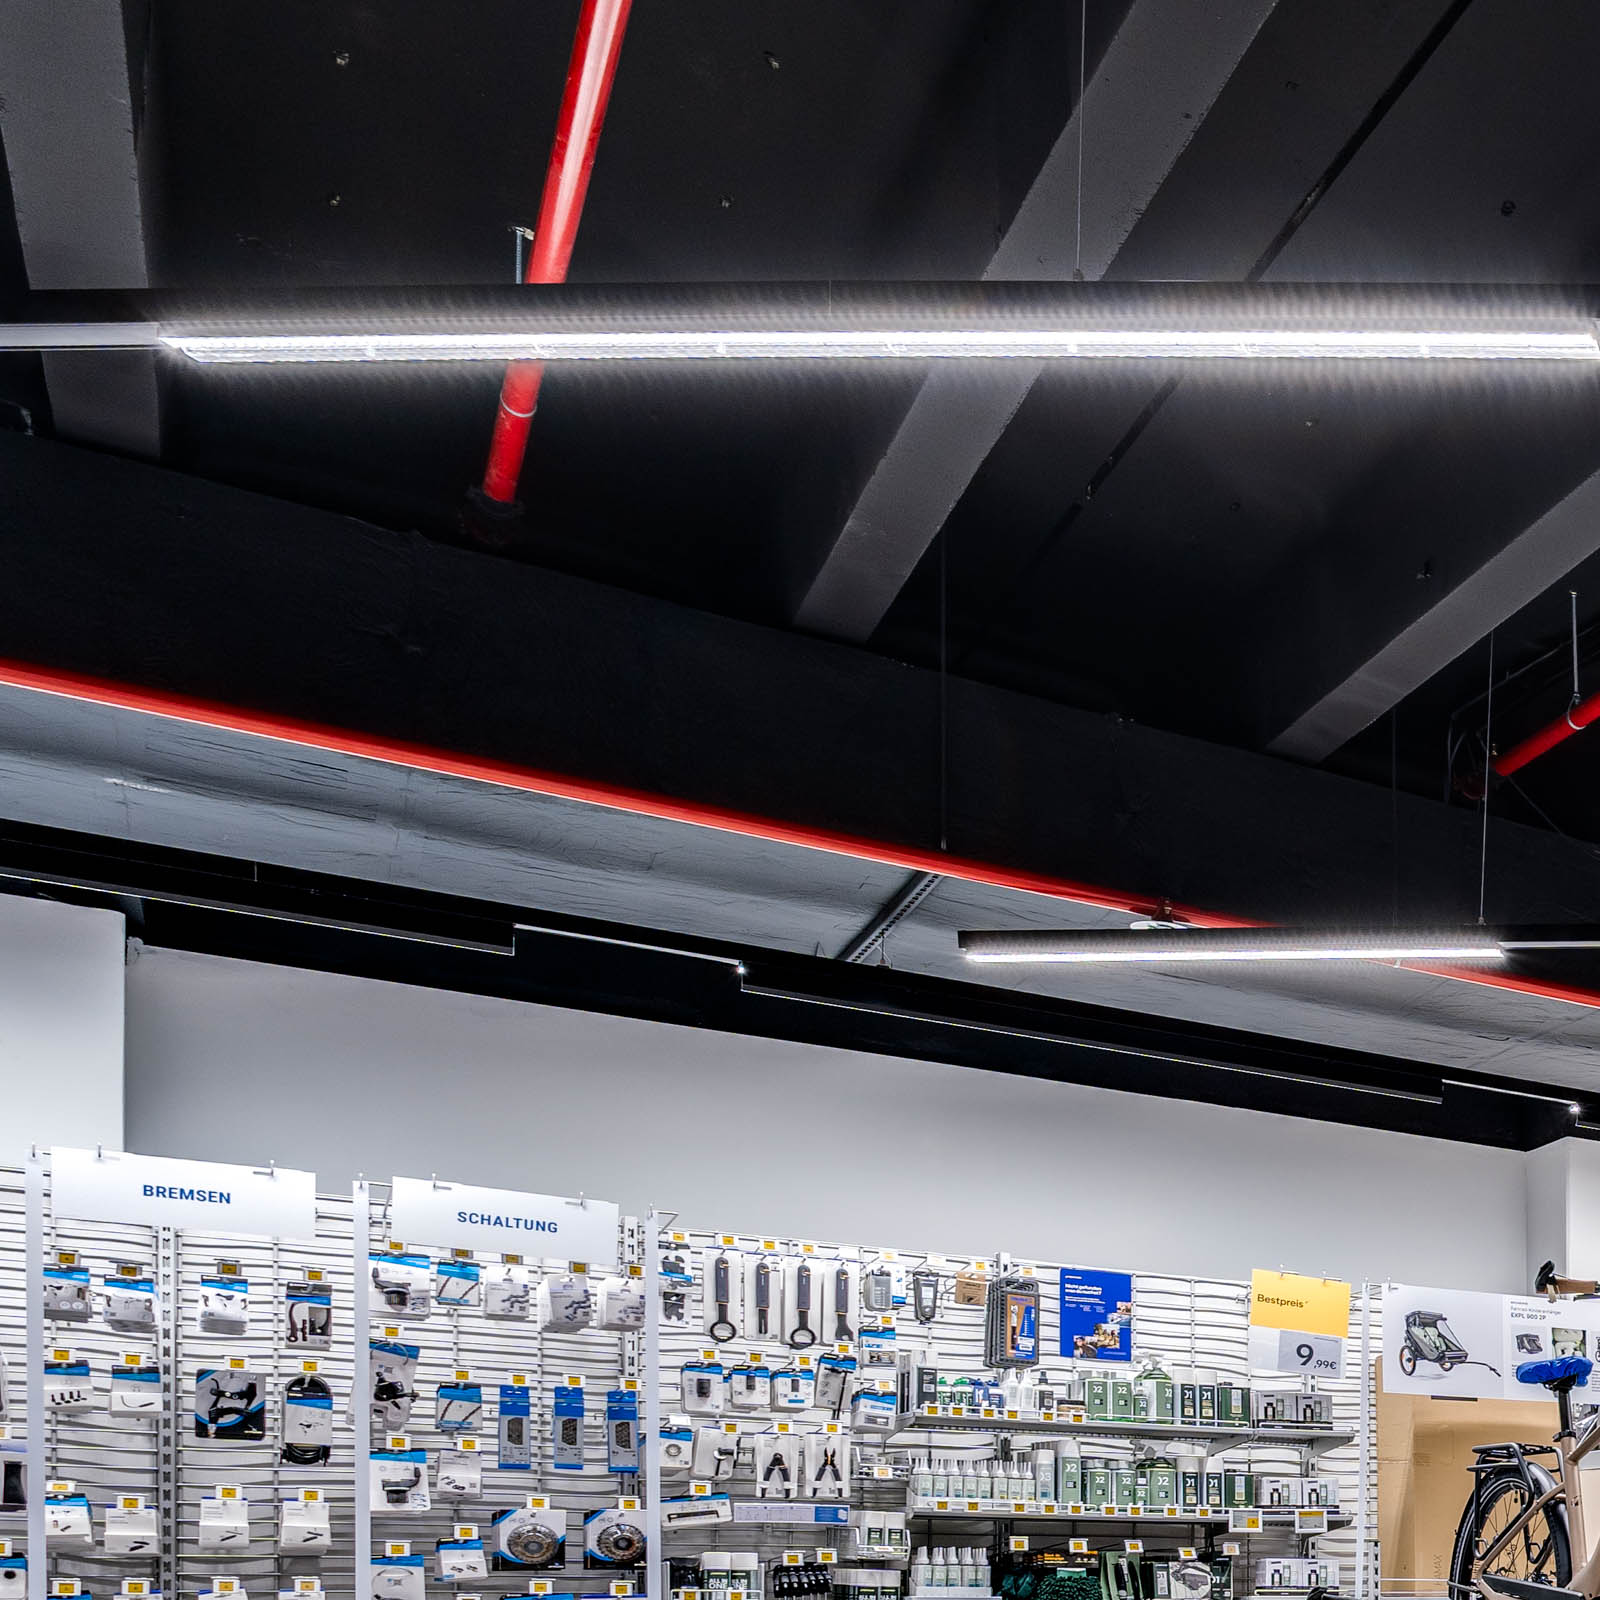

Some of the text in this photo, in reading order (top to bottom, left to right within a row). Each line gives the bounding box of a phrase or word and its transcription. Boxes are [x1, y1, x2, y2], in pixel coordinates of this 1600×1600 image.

[142, 1184, 232, 1204] BREMSEN
[457, 1211, 559, 1234] SCHALTUNG
[1257, 1294, 1304, 1308] Bestpreis
